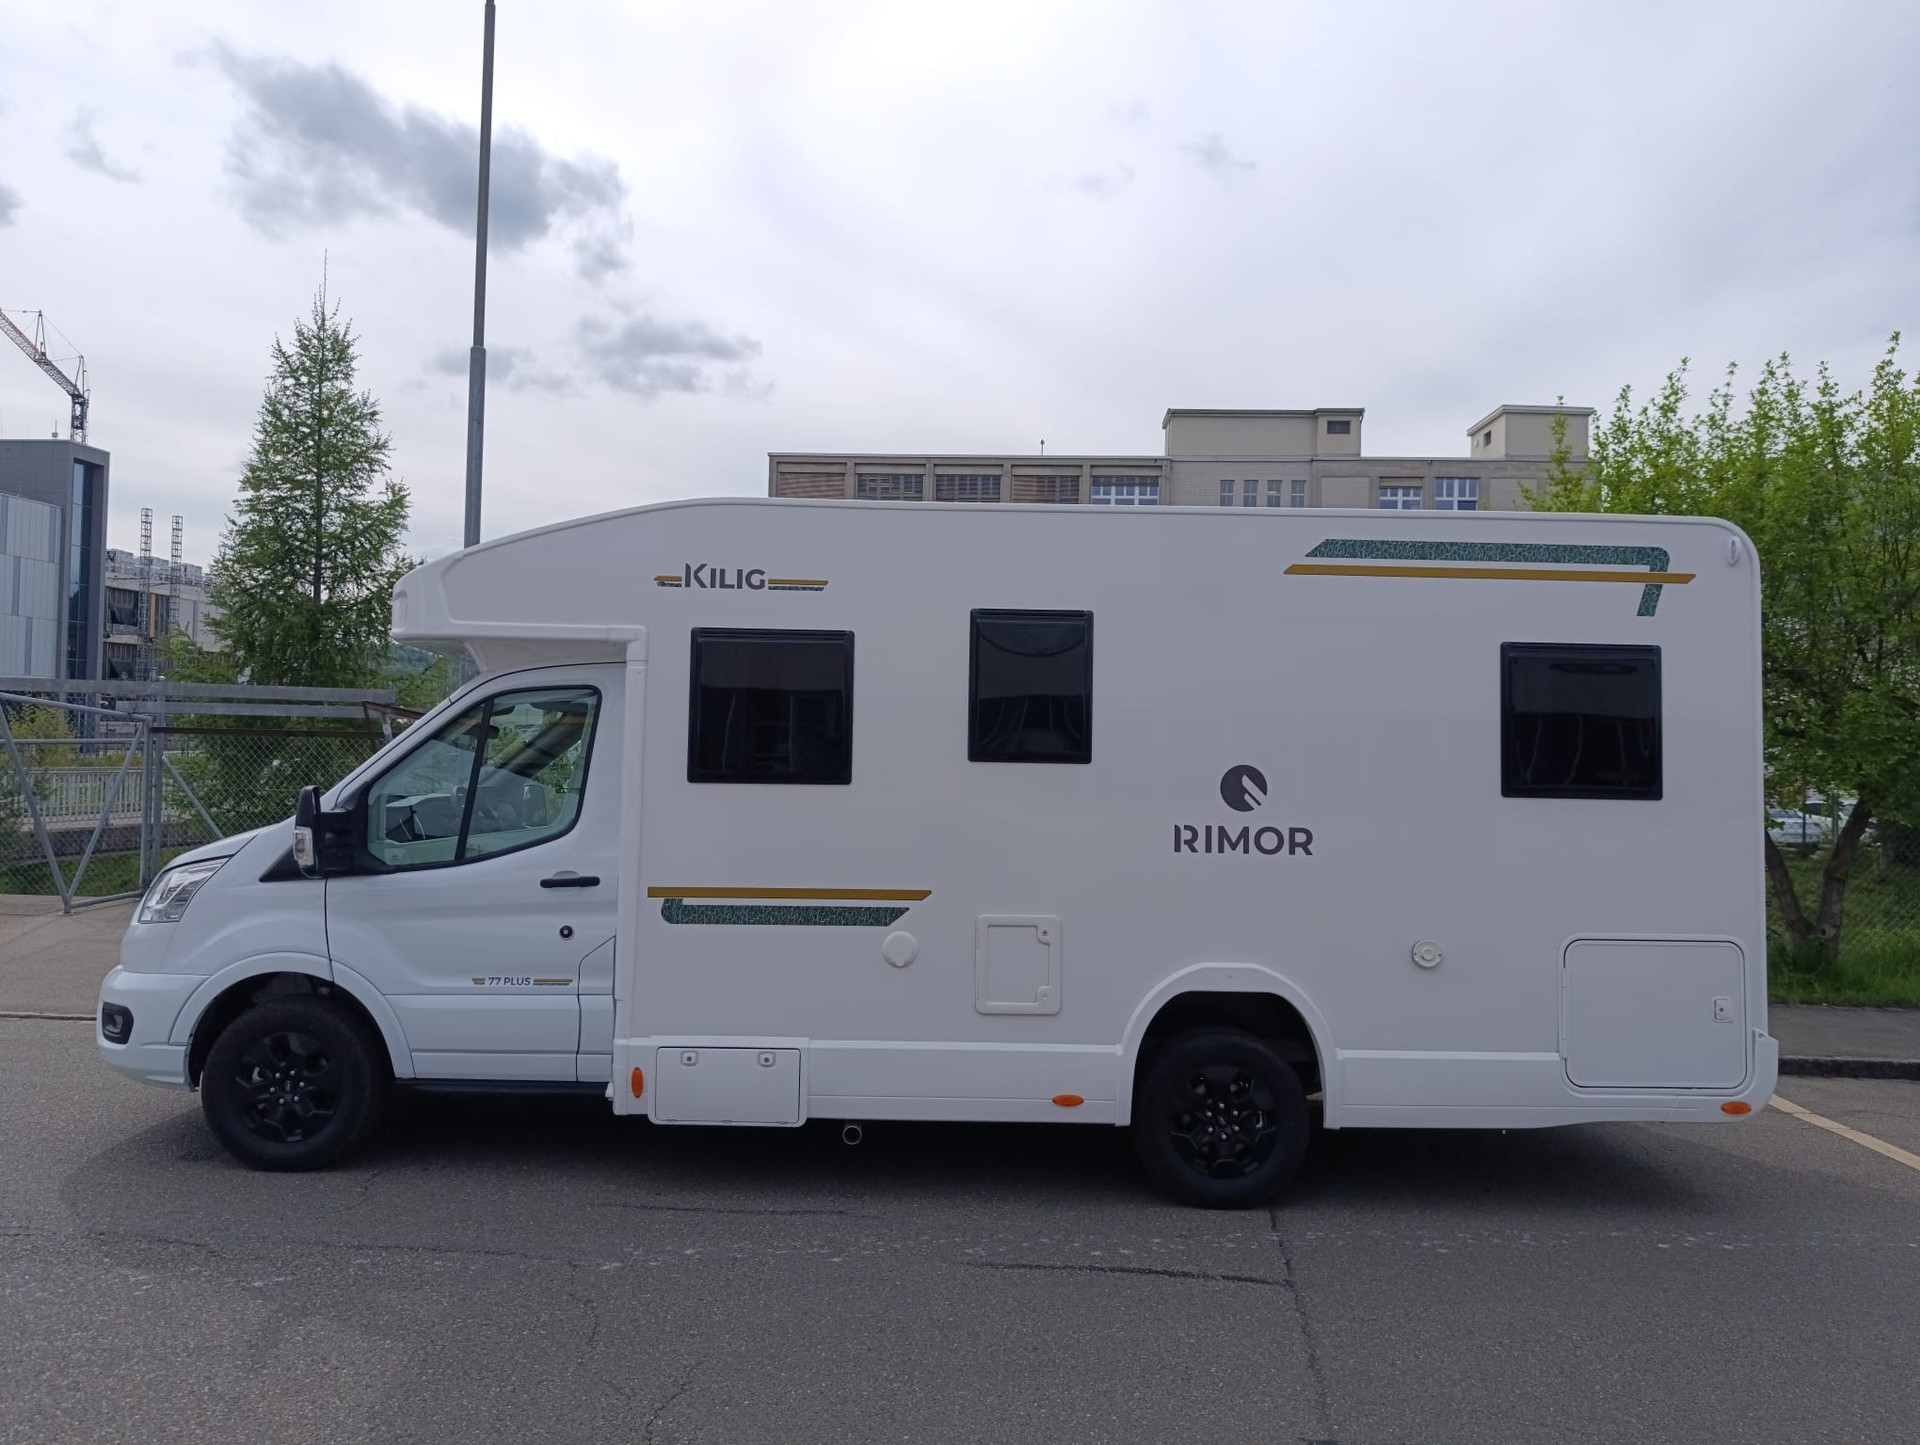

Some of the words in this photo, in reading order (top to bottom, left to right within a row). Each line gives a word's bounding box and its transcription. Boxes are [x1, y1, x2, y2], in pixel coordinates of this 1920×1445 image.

[684, 562, 766, 590] KILIG
[1173, 824, 1314, 856] RIMOR
[488, 976, 502, 986] 77
[503, 977, 531, 986] PLUS
